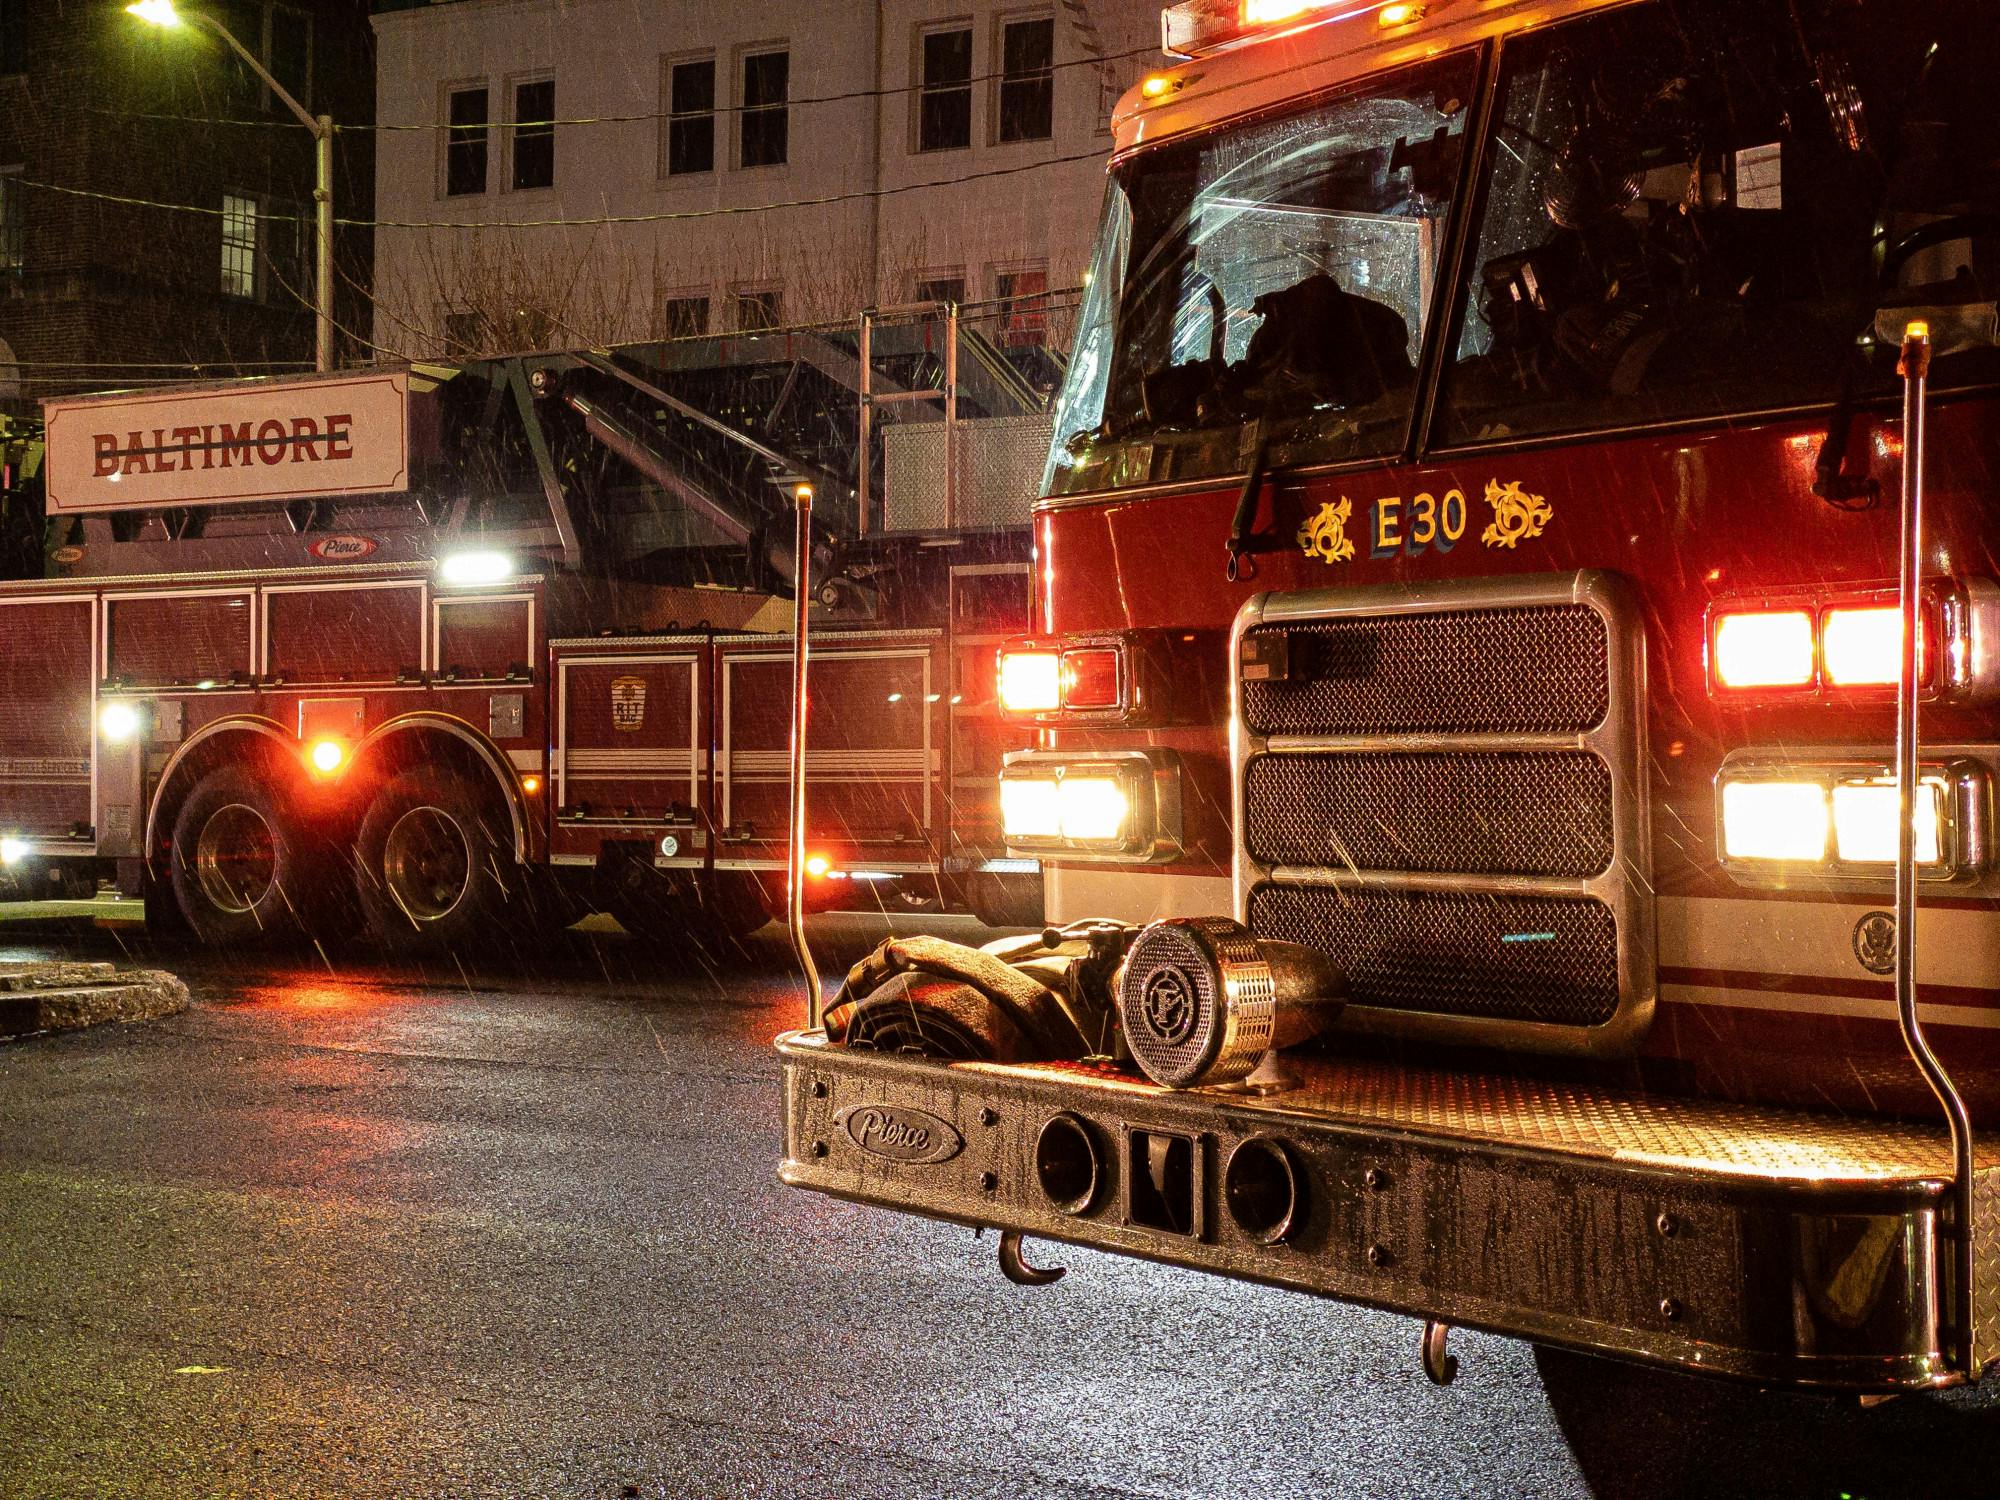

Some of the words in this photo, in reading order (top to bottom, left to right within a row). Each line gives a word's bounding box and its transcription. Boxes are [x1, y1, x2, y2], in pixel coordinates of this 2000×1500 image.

[92, 413, 353, 477] BALTIMORE
[323, 539, 362, 557] Pierce
[616, 702, 641, 714] RIT
[858, 1108, 931, 1151] Pierce
